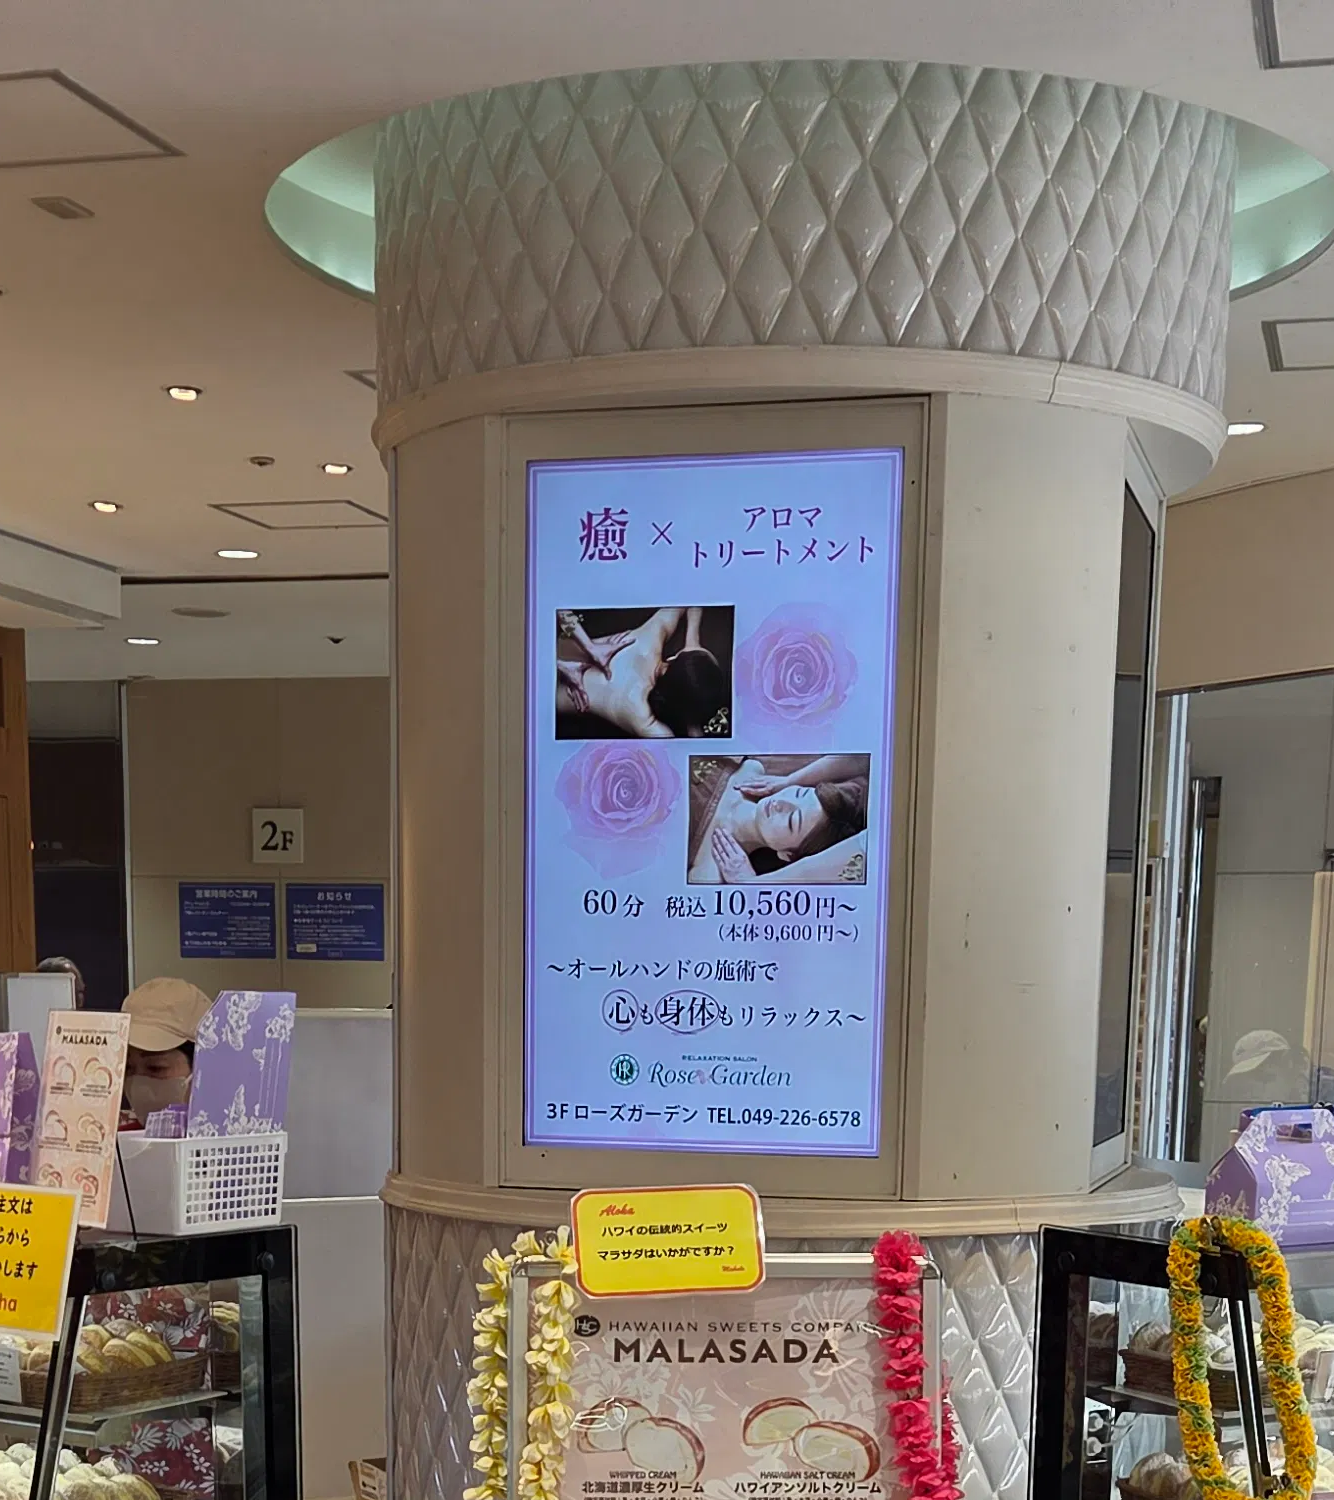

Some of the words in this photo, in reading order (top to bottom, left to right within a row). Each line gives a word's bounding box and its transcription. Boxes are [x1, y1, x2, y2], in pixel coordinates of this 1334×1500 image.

[743, 506, 823, 532] アロマ
[579, 507, 630, 562] 癒
[693, 535, 875, 568] トリートメント
[260, 820, 294, 851] 2F
[61, 1035, 108, 1046] MALASADA
[648, 1060, 698, 1087] Rose
[711, 1063, 791, 1087] Garden
[707, 1107, 862, 1128] TEL.049-226-6578
[599, 1204, 635, 1217] Aloha
[602, 1223, 728, 1237] ハワイの伝統的スイーツ
[597, 1246, 734, 1261] マラサダはいかがですか？
[609, 1321, 698, 1332] HAWAIIAN
[707, 1321, 782, 1333] SWEETS
[613, 1338, 840, 1364] MALASADA
[648, 1471, 677, 1479] CREAM
[804, 1471, 825, 1479] SALT
[827, 1471, 856, 1479] CREAM
[582, 1481, 704, 1494] 北海道濃厚生クリーム
[734, 1481, 881, 1494] ハワイアンソルトクリーム
